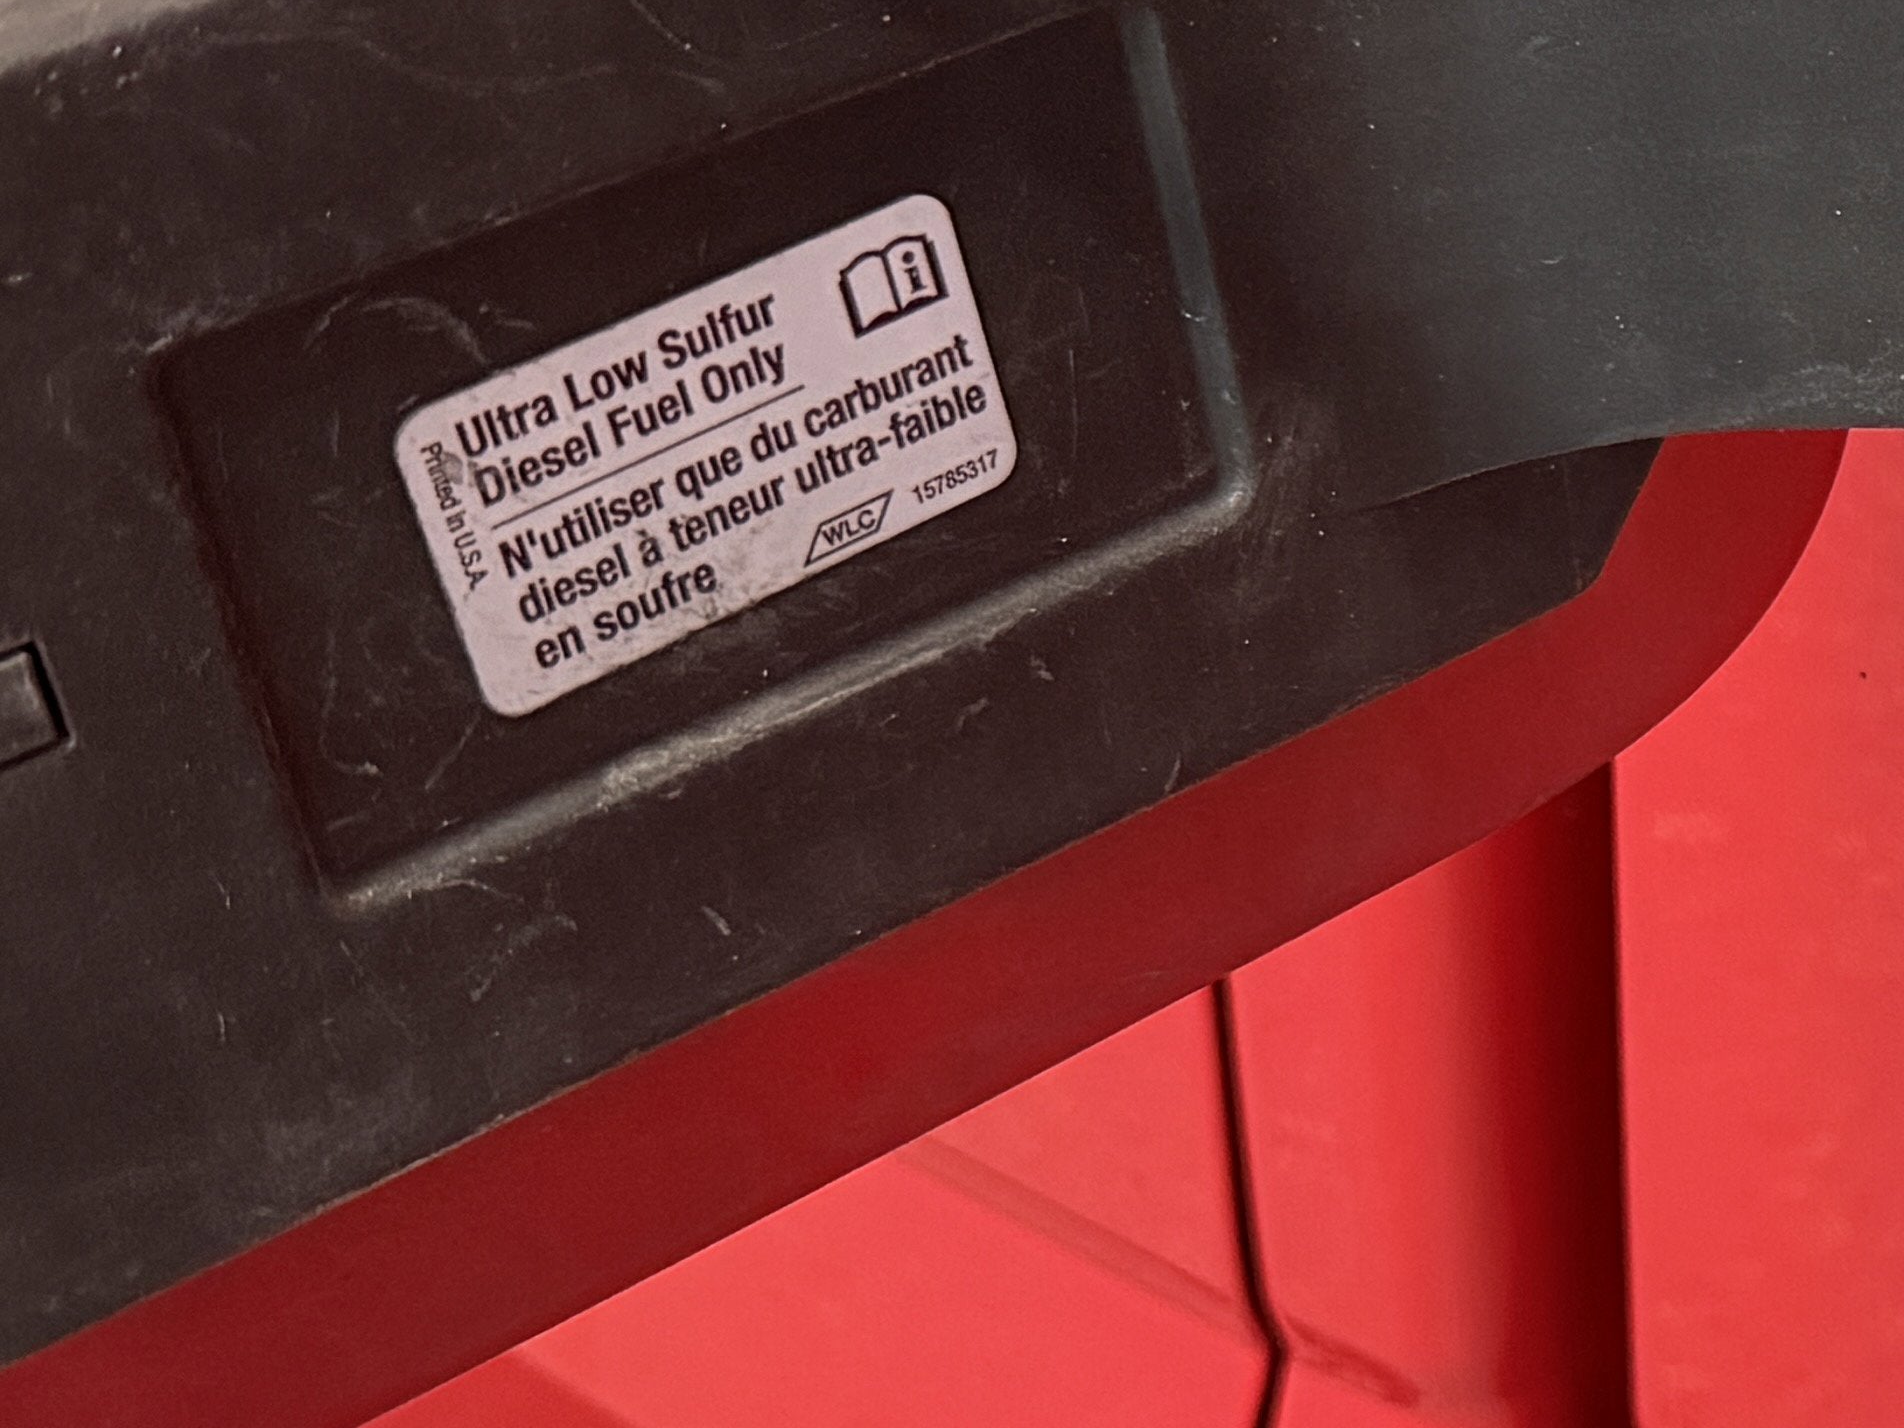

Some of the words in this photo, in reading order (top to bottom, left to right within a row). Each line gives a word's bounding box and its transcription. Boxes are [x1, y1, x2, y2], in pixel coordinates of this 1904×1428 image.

[455, 394, 558, 458] Ultra
[563, 350, 648, 412] Low
[657, 293, 775, 370] Sulfur
[474, 421, 601, 508] Diesel
[607, 378, 695, 448] Fuel
[701, 343, 784, 404] Only
[446, 509, 467, 533] in
[499, 478, 665, 578] N'utiliser
[675, 446, 743, 500] que
[750, 420, 798, 462] du
[804, 334, 973, 437] carburant
[519, 542, 632, 623] diesel
[638, 528, 664, 568] à
[669, 475, 785, 552] teneur
[795, 384, 986, 493] ultra-faible
[912, 449, 997, 504] 15785317
[822, 509, 876, 546] WLC
[535, 625, 586, 669] en
[593, 563, 717, 641] soufre
